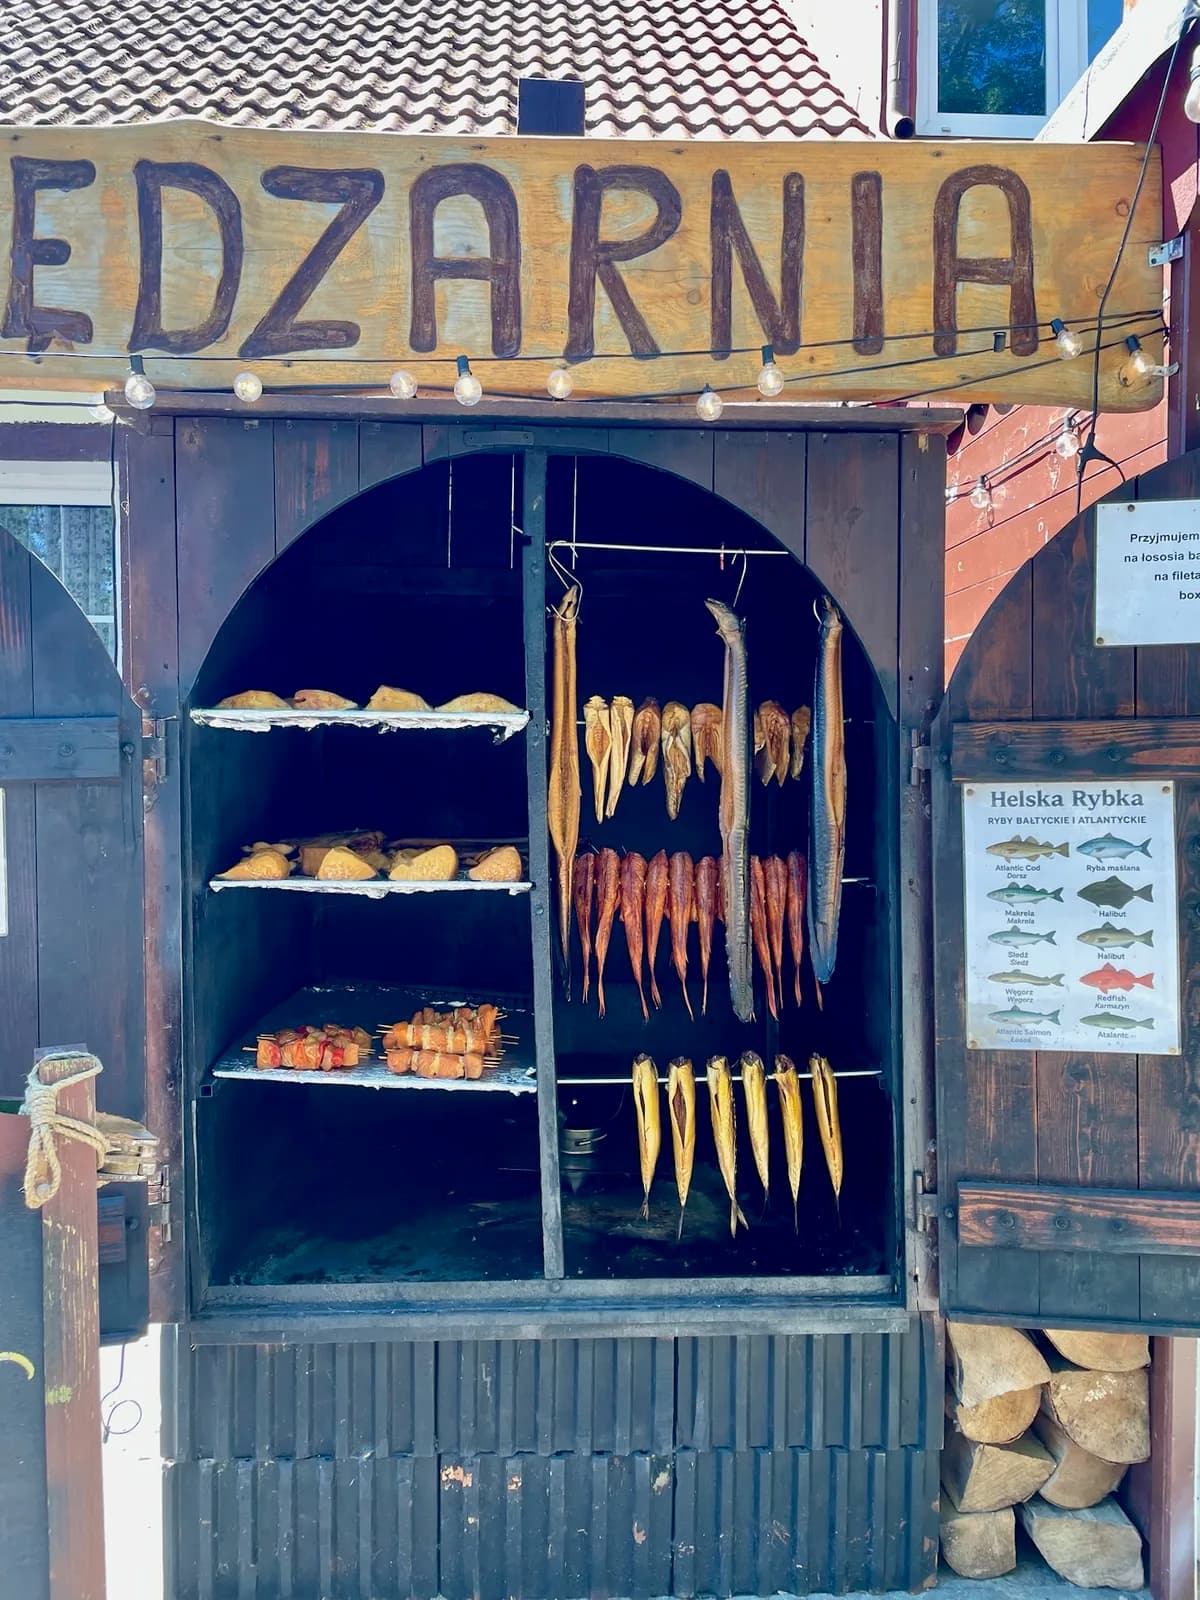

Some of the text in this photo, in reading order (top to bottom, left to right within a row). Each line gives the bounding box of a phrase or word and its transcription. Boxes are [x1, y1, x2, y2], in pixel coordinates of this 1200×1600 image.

[1130, 532, 1200, 545] Przyjmujem
[1124, 555, 1138, 563] na
[1142, 552, 1184, 562] łososia
[1154, 573, 1168, 581] na
[991, 789, 1144, 811] Helska Rybka
[988, 816, 1147, 825] RYBY BAŁTYCKIE I ATLANTYCKIE
[1025, 864, 1041, 872] Cod
[1108, 864, 1140, 872] maślana
[1097, 994, 1127, 1002] Redfish
